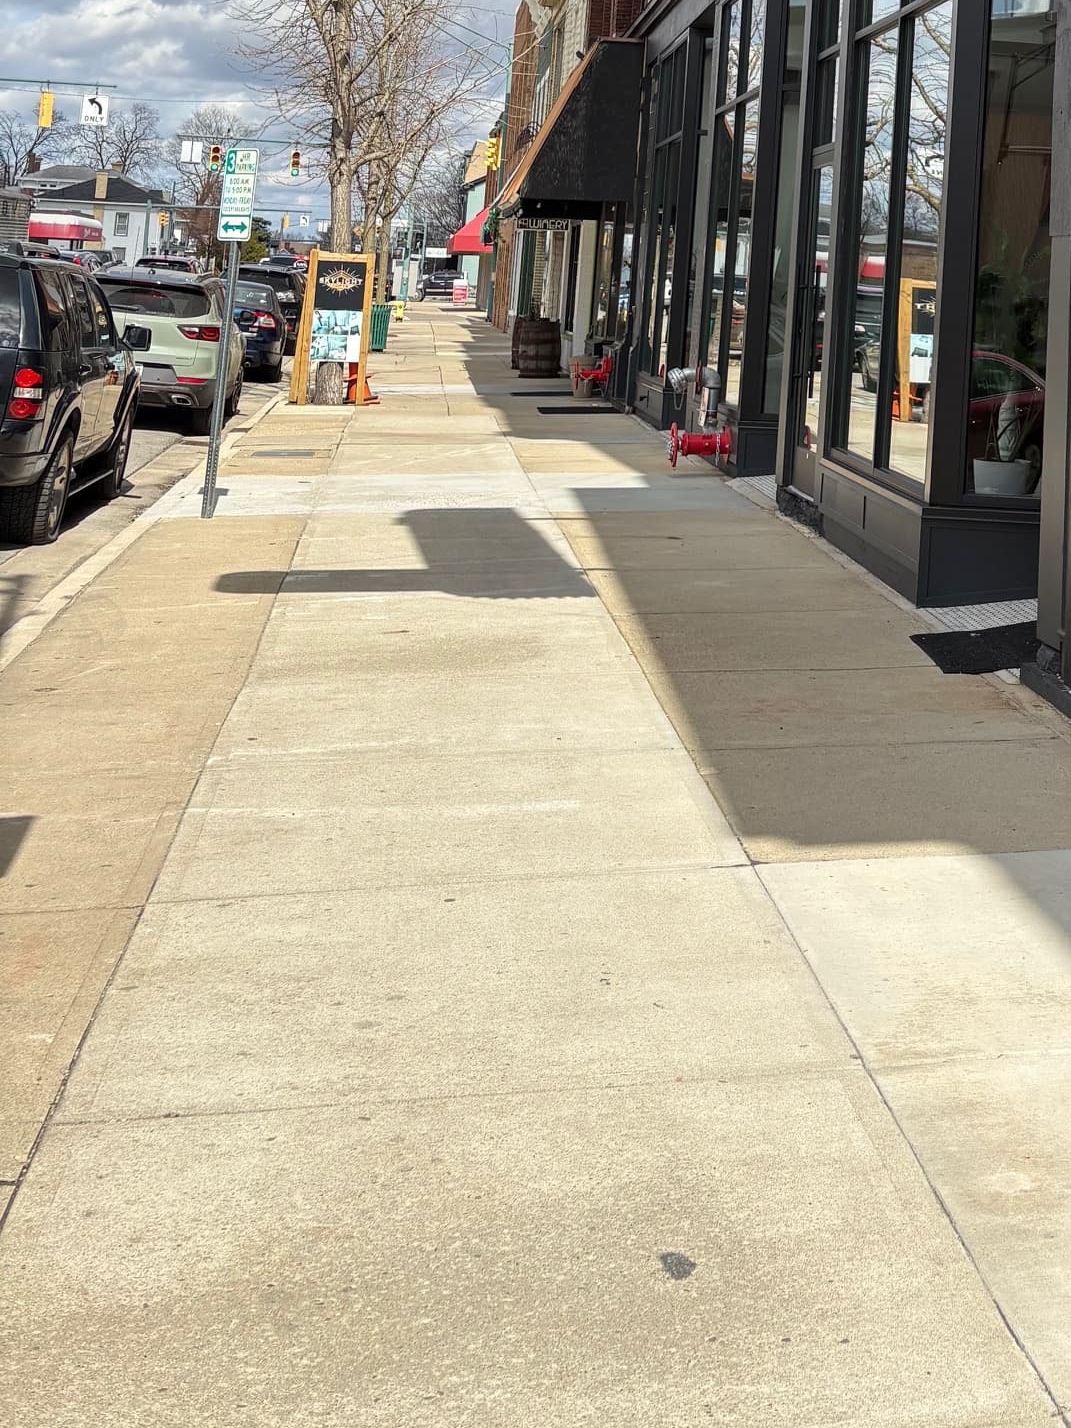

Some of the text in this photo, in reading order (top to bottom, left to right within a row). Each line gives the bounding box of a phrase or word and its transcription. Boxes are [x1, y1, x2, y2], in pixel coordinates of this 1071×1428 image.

[84, 115, 104, 123] ONLY
[242, 152, 251, 161] HR
[227, 152, 236, 172] 3
[235, 163, 256, 172] PARKING
[319, 276, 364, 286] SKYLIGHT
